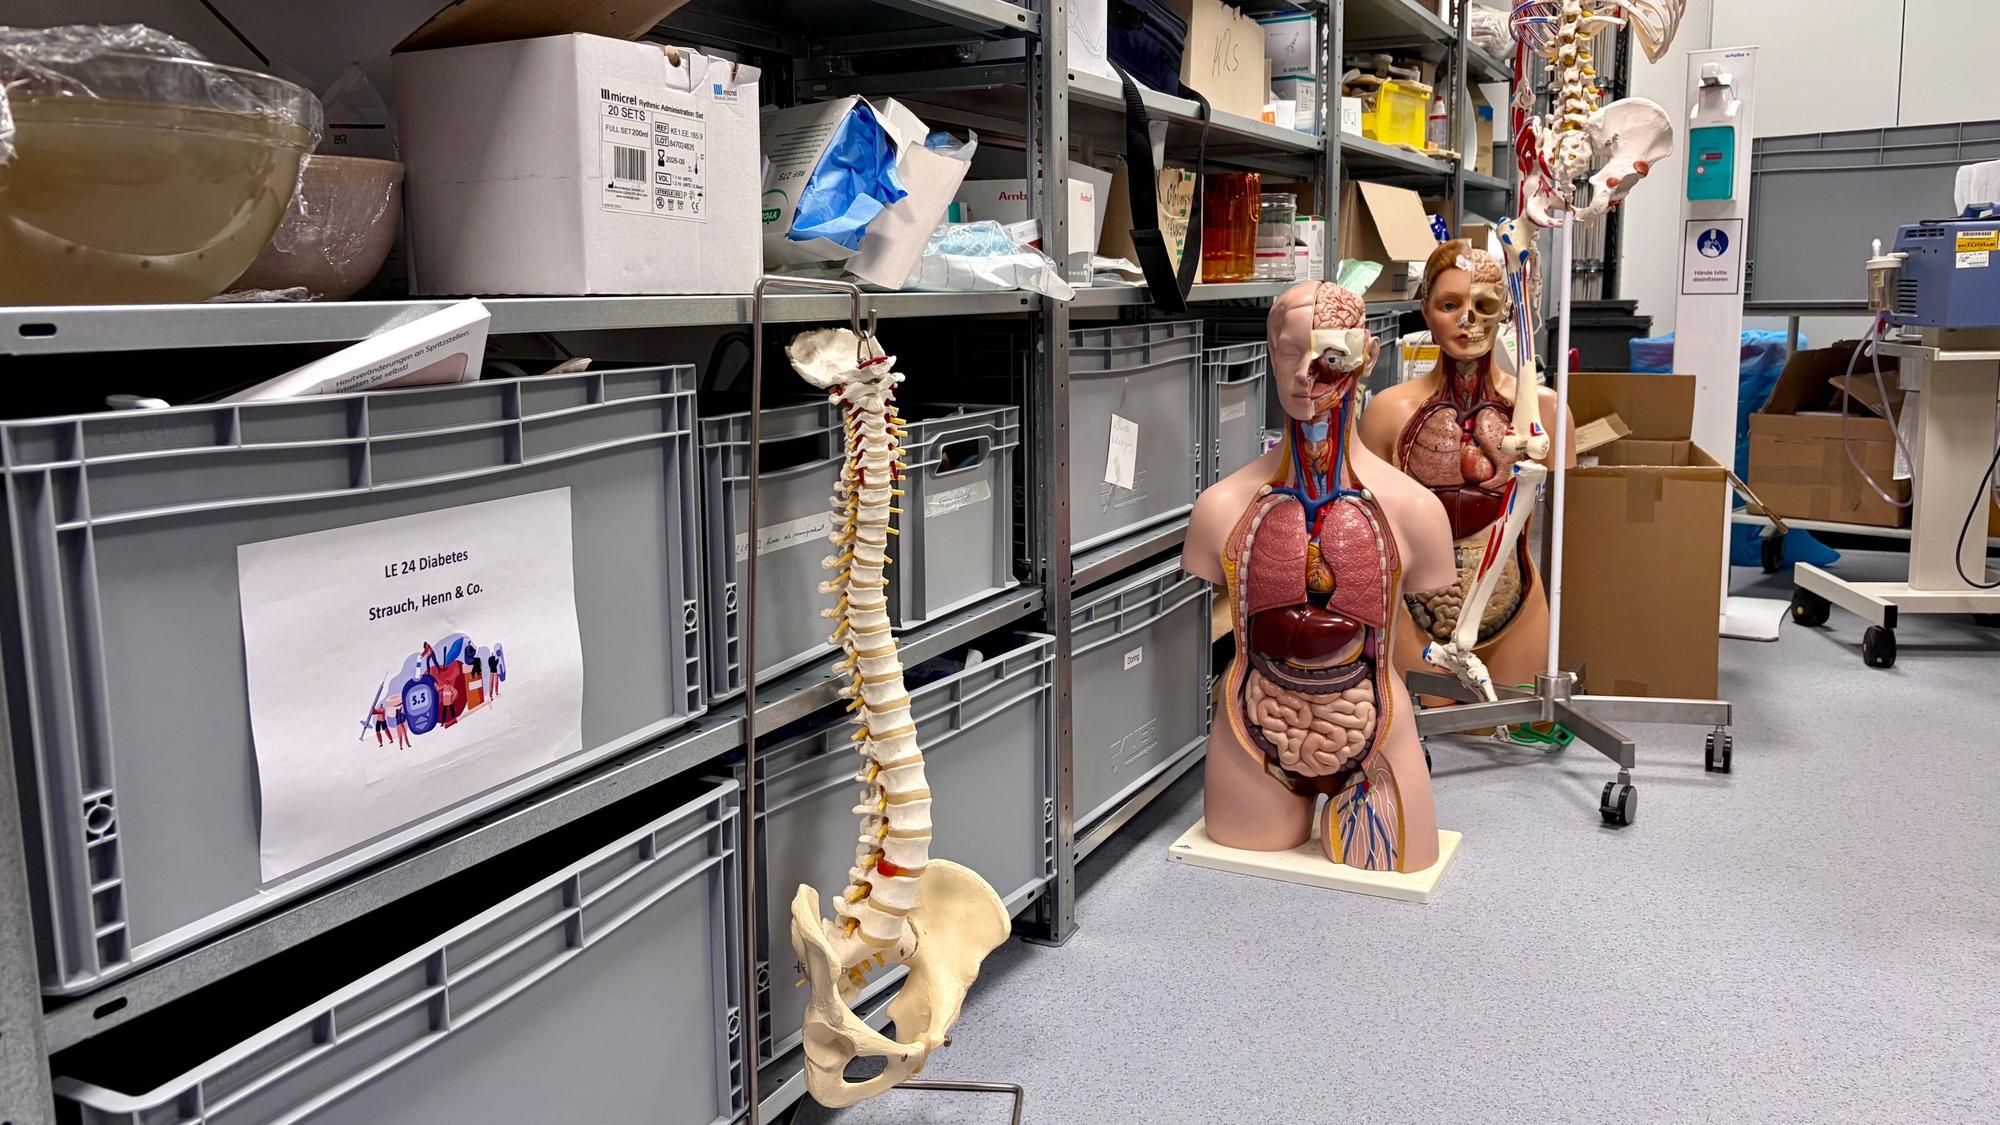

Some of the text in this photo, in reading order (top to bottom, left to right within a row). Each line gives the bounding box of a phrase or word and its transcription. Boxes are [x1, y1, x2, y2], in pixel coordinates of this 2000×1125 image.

[608, 104, 646, 121] 20 SETS
[610, 92, 704, 120] micrel Rythmic Administration Set
[605, 124, 620, 134] FULL
[656, 124, 668, 132] REF
[656, 137, 668, 145] LOT
[658, 175, 669, 183] VOL
[998, 191, 1027, 201] Amb
[335, 329, 471, 387] Hautveränderungen an Spritzstellen:
[336, 363, 409, 393] Ertasten Sie selbst!
[384, 550, 469, 579] LE 24 Diabetes
[368, 582, 483, 621] Strauch, Henn & Co.
[412, 692, 426, 706] 5.5
